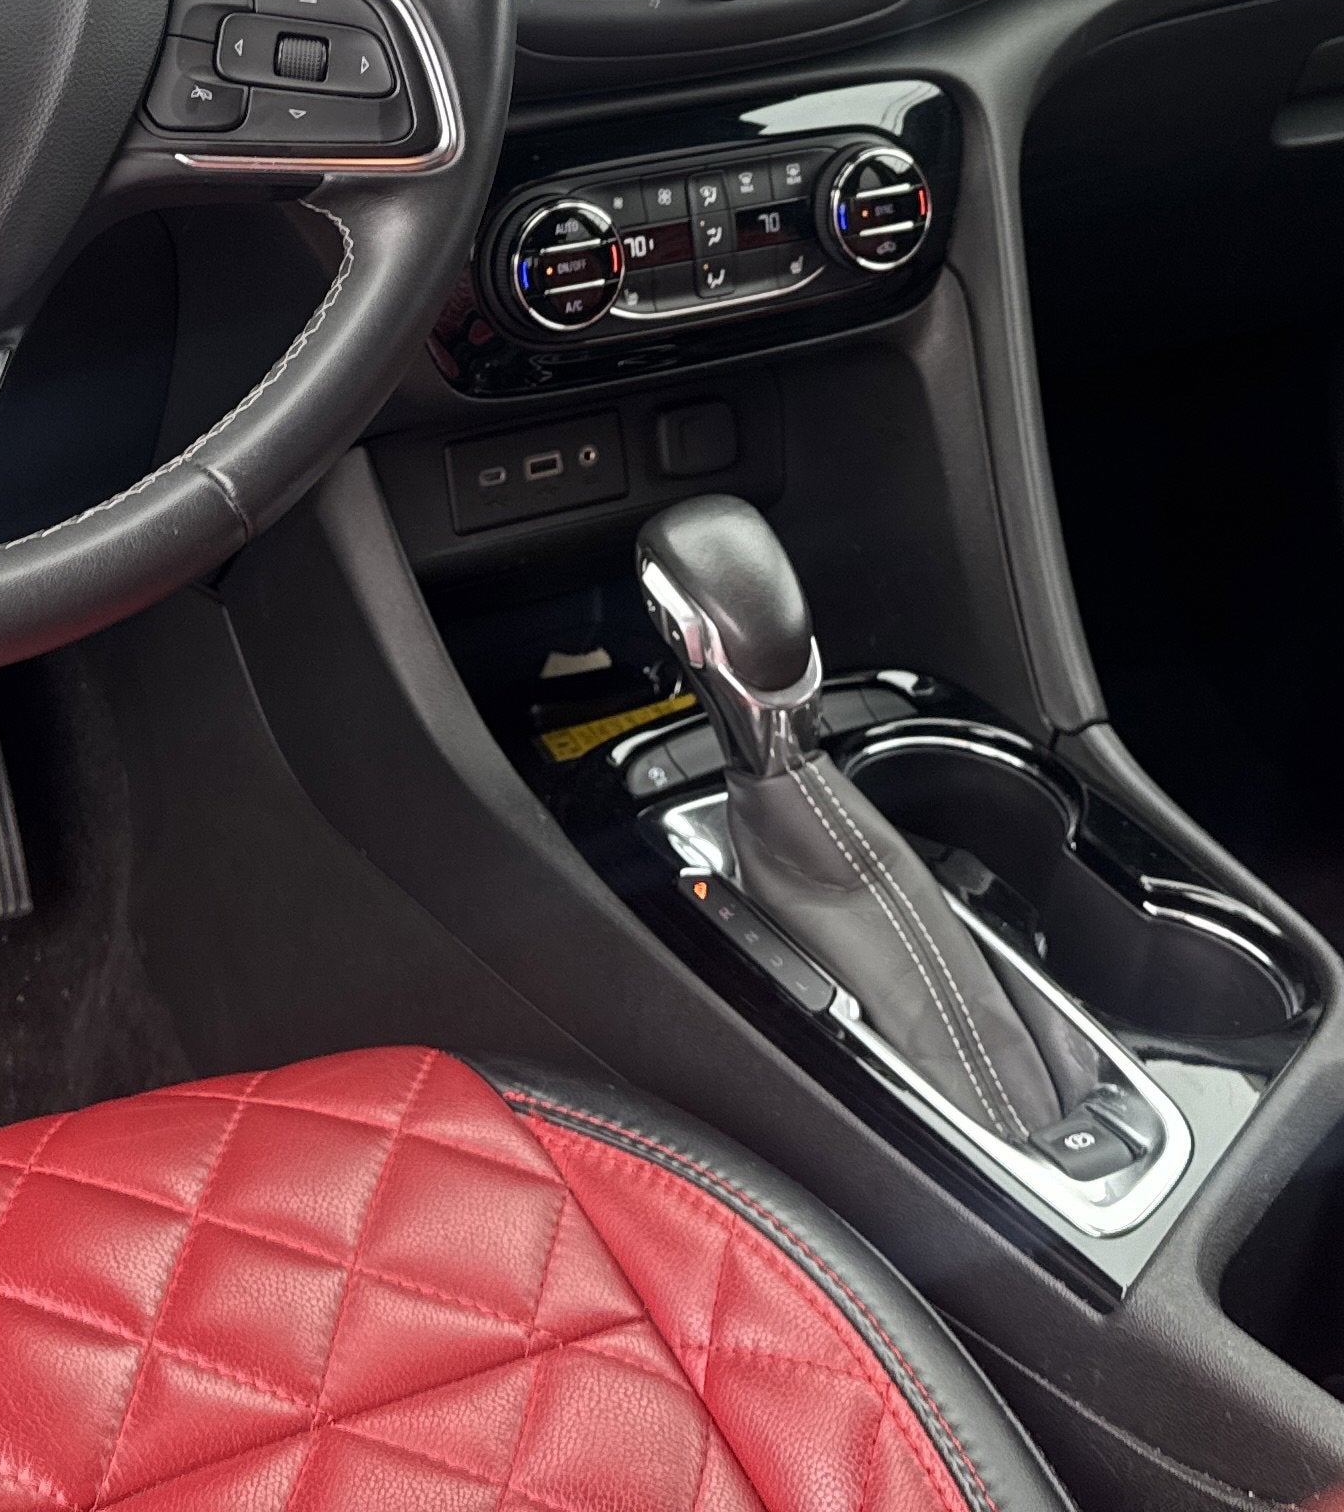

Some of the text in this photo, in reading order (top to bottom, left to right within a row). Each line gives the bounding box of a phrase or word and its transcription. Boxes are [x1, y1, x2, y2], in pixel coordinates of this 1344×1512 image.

[554, 221, 579, 236] AUTO
[758, 212, 782, 233] 70
[623, 234, 647, 258] 70
[557, 258, 587, 275] ON/OFF
[565, 299, 584, 314] A/C
[718, 906, 735, 921] R
